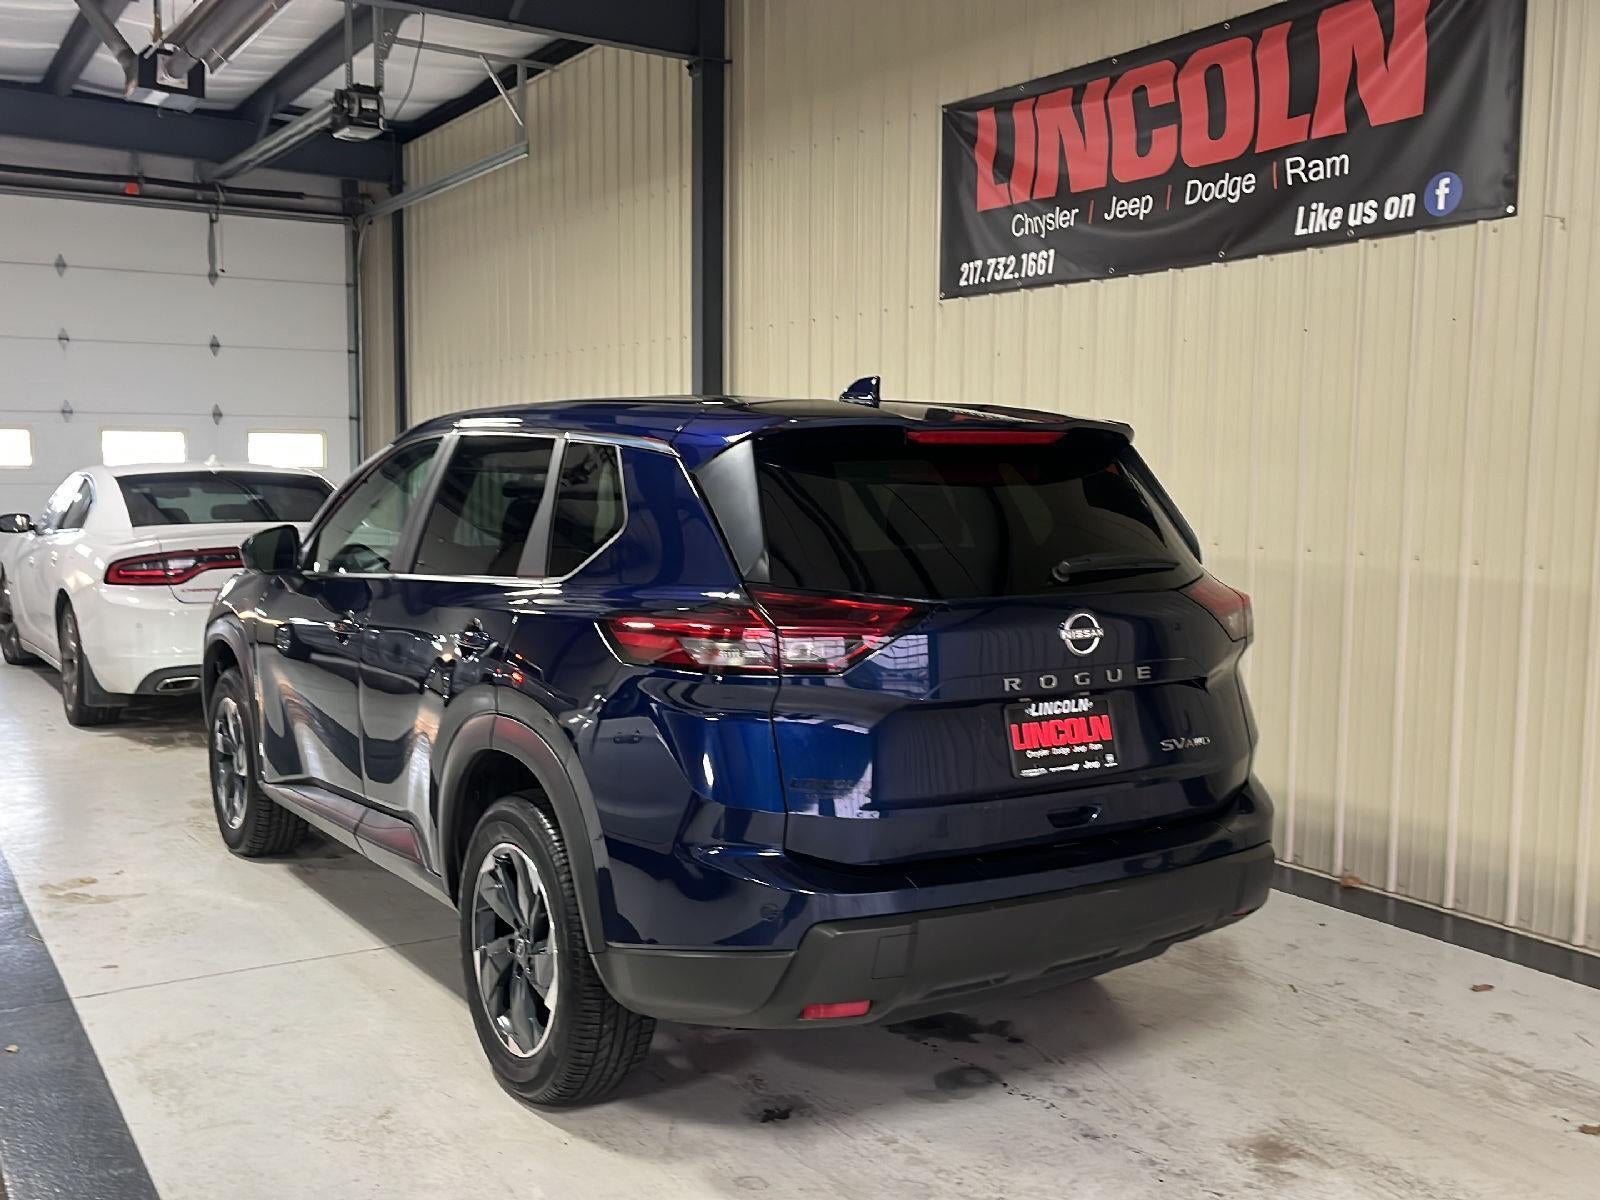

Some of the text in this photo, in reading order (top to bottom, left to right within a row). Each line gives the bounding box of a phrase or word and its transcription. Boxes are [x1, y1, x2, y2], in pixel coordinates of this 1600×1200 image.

[975, 0, 1430, 212] LINCOLN
[1011, 153, 1350, 238] Chrysler Jeep Dodge Ram
[1293, 202, 1344, 236] Like
[1347, 198, 1378, 228] us
[1383, 192, 1417, 221] on
[958, 248, 1056, 287] 217.732.1661
[1060, 628, 1104, 640] NISSAN
[1002, 664, 1153, 692] ROGUE
[1030, 697, 1090, 717] LINCOLN
[1010, 714, 1113, 751] LINCOLN
[1160, 737, 1185, 752] SV
